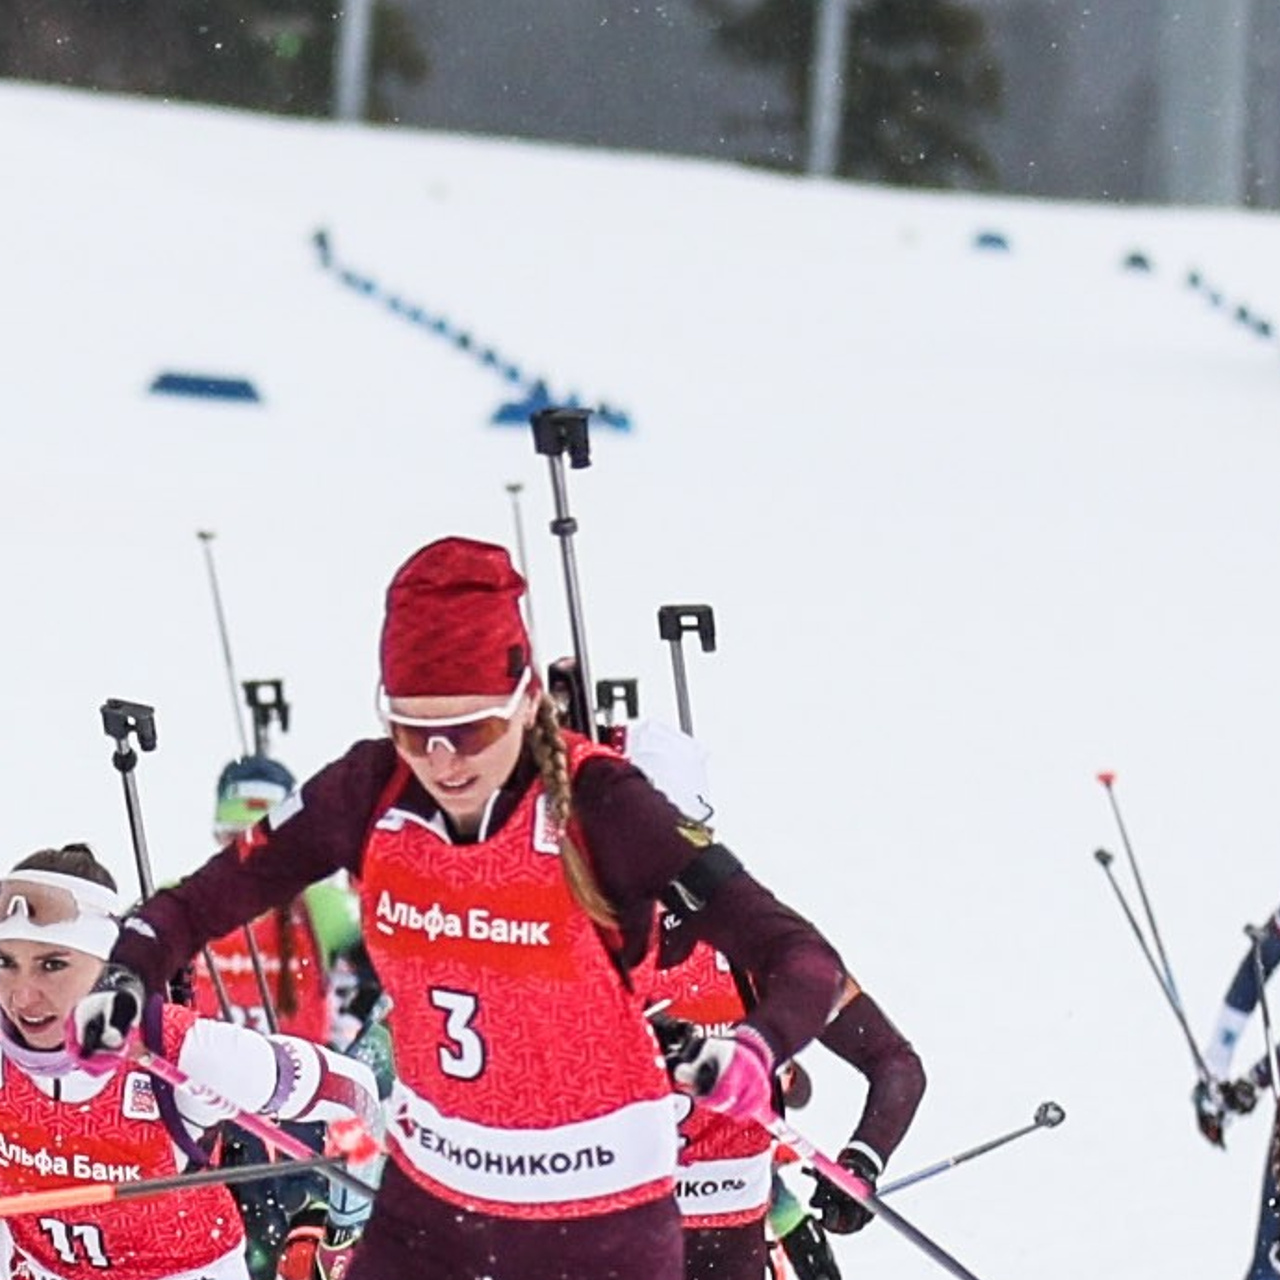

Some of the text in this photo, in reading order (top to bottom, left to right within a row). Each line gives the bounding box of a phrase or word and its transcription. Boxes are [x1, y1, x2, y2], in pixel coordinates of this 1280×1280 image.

[376, 890, 550, 945] Альфа Банк
[429, 986, 486, 1081] 3
[73, 1154, 141, 1183] Банк
[38, 1216, 110, 1269] 11
